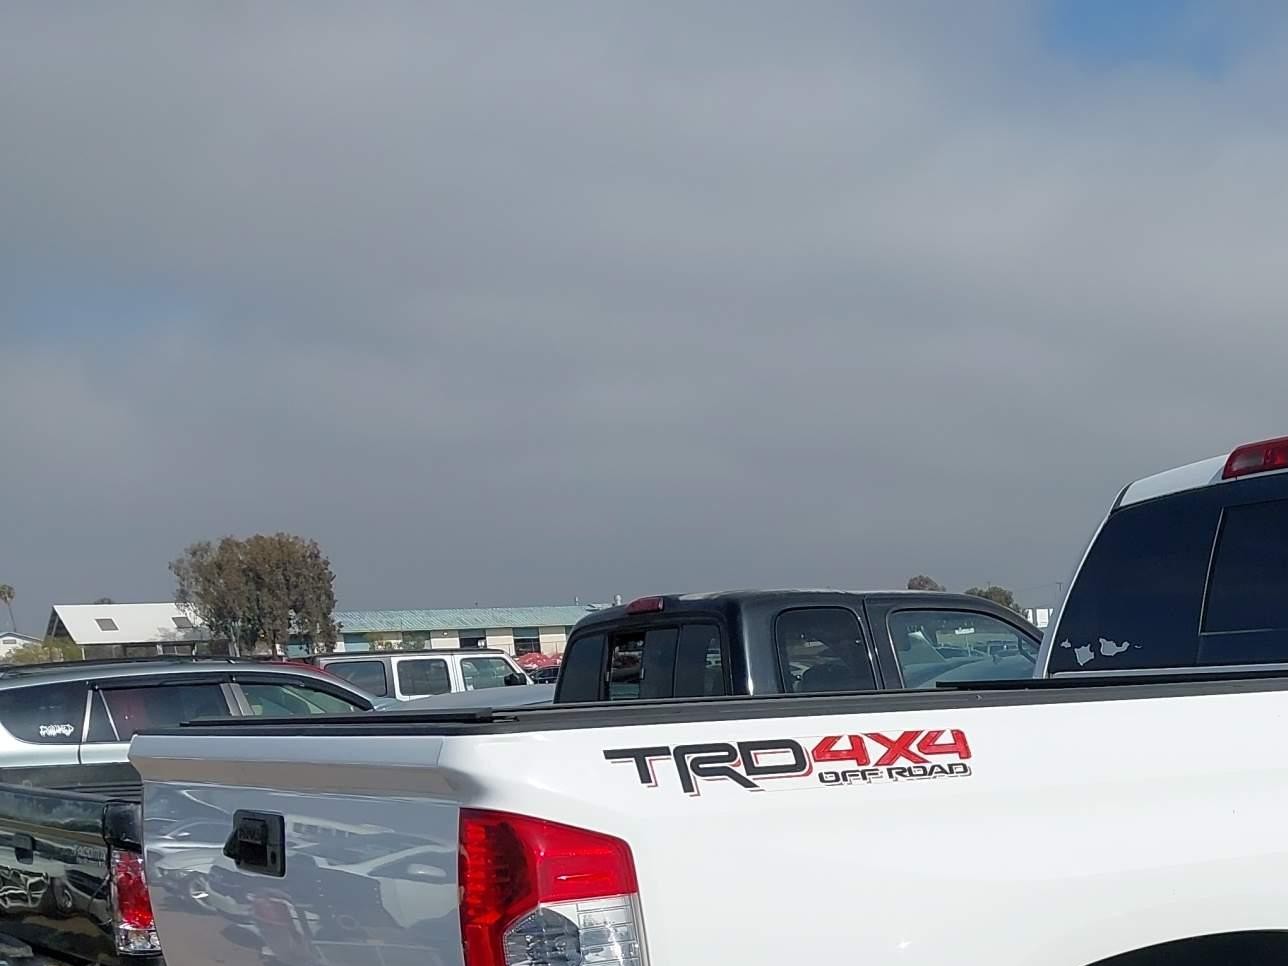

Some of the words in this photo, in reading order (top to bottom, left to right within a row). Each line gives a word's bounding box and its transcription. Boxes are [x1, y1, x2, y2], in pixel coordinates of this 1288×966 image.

[603, 738, 812, 796] TRD
[817, 768, 880, 785] OFF
[887, 762, 972, 780] ROAD
